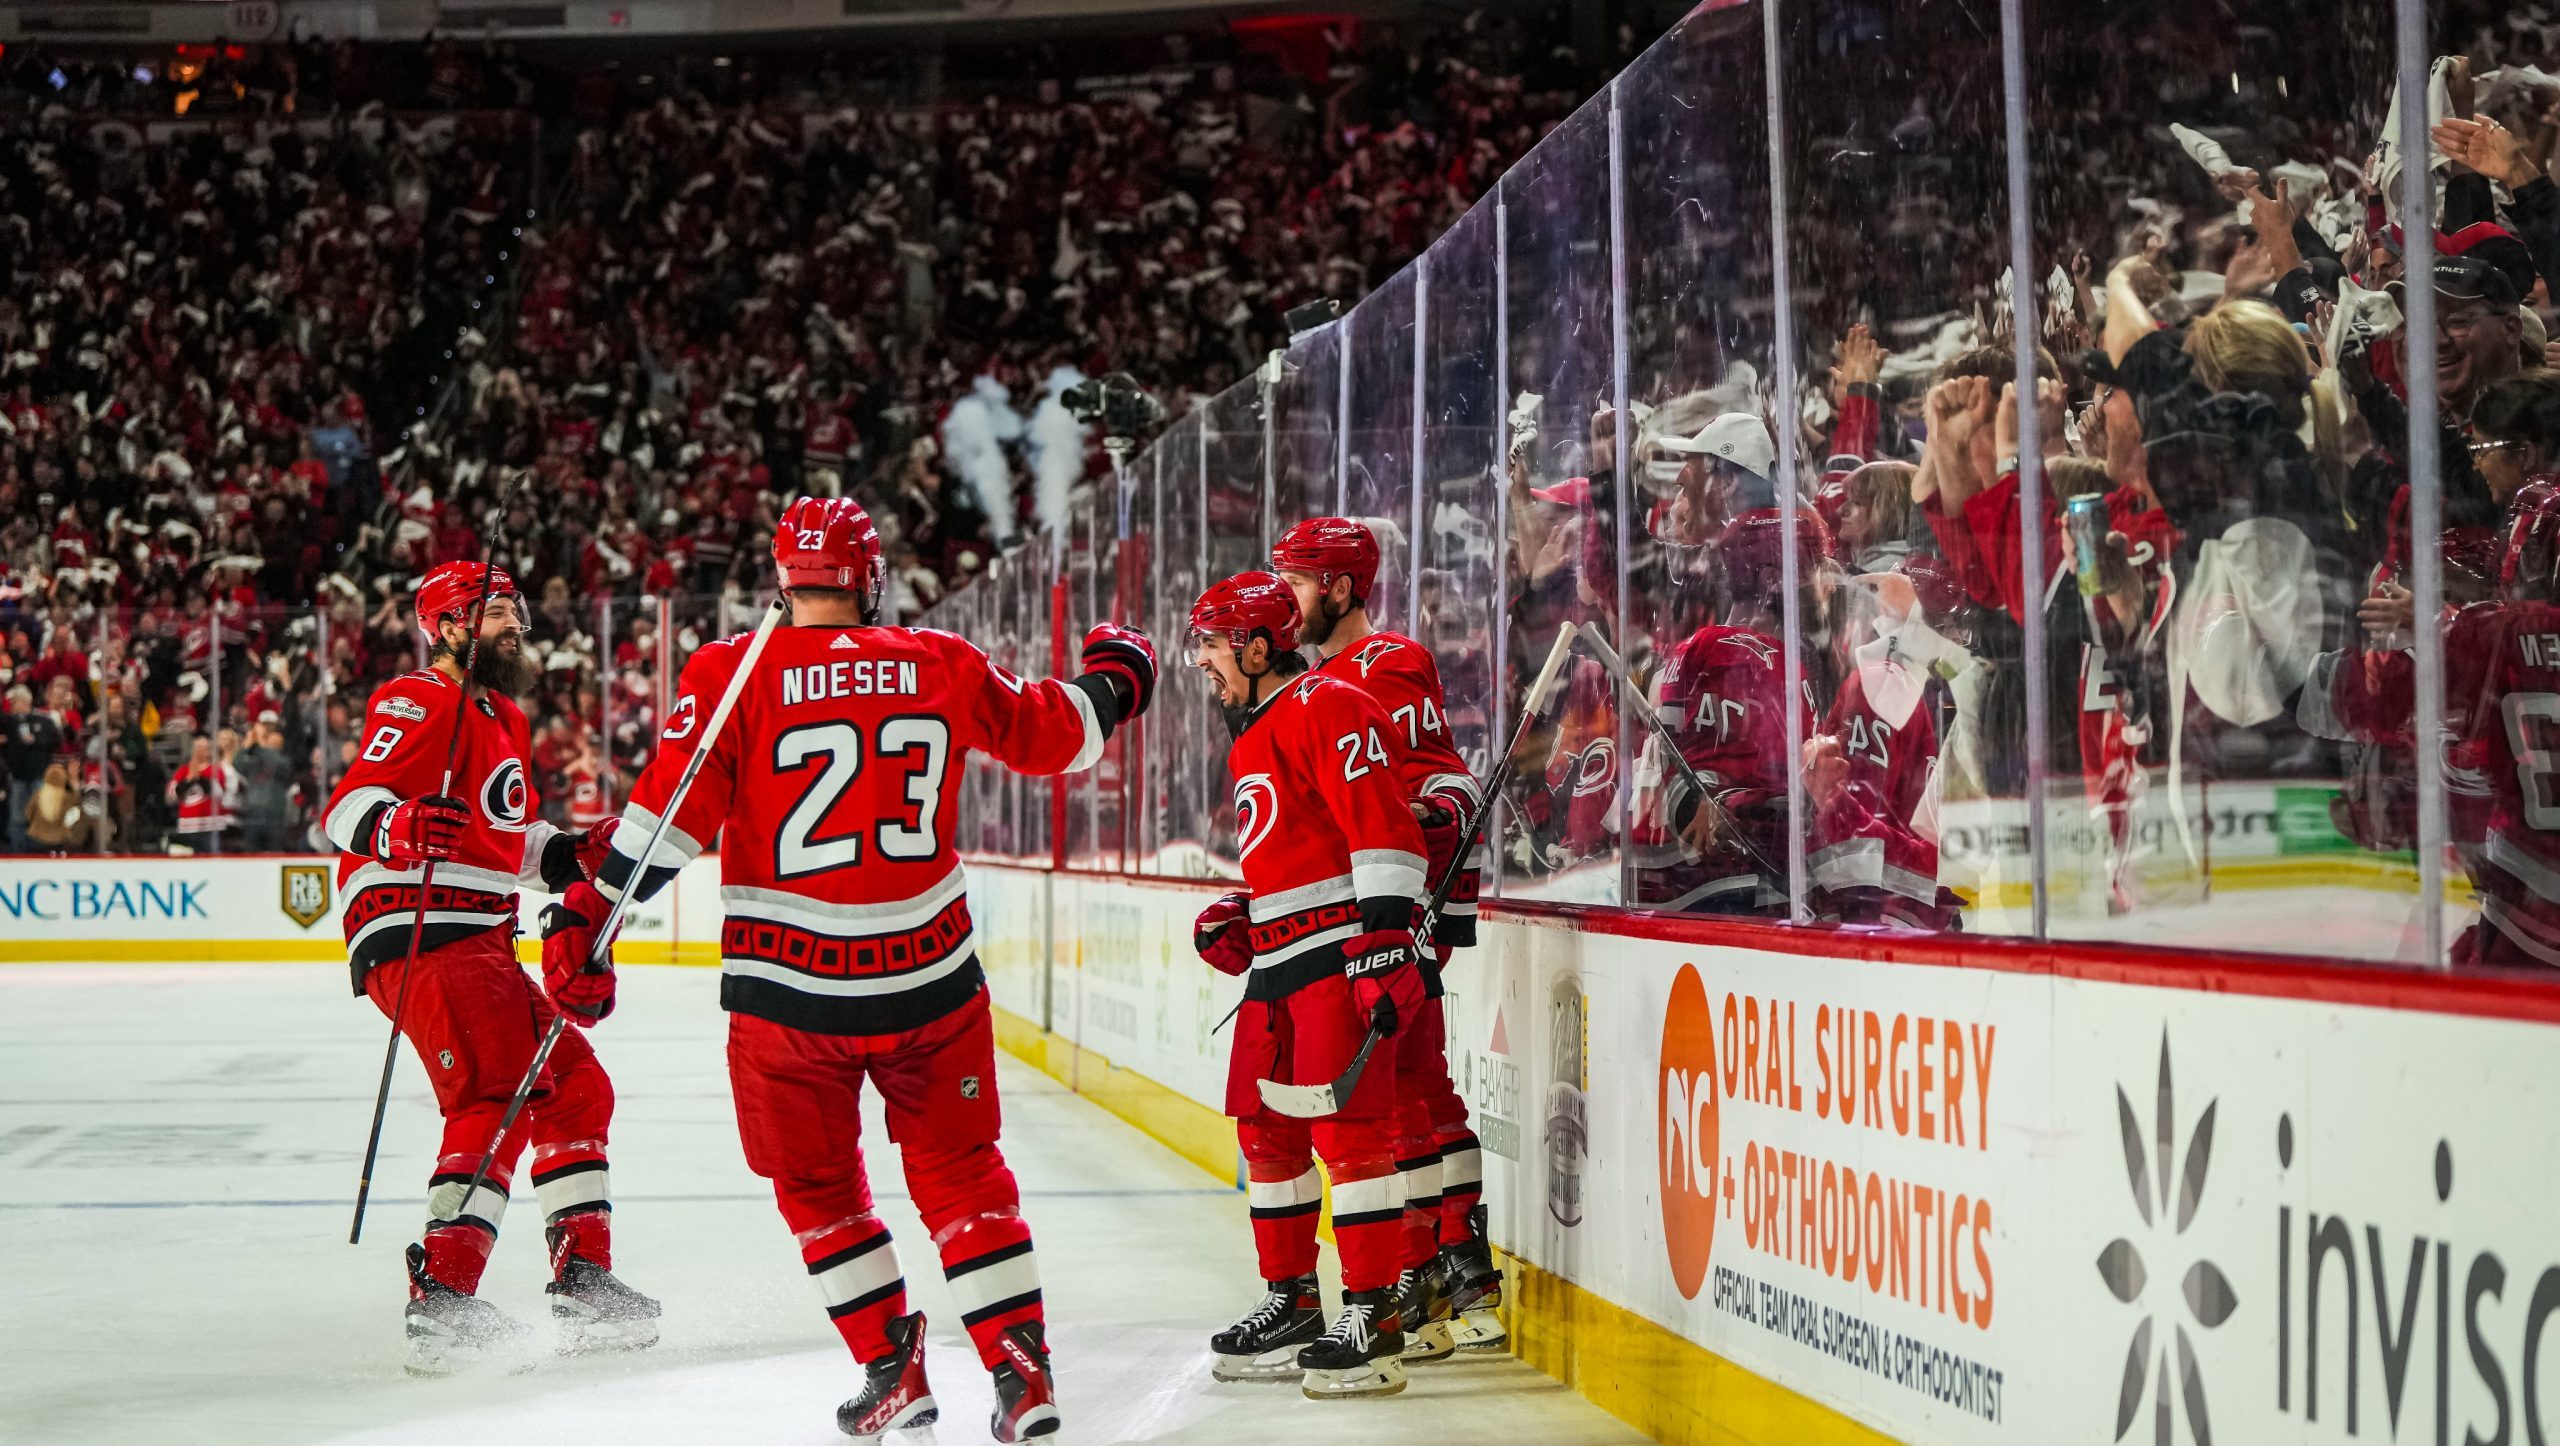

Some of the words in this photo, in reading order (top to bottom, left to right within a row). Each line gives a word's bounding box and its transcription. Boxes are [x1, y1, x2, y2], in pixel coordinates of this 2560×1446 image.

[796, 529, 825, 550] 23
[1235, 582, 1279, 597] TOPGOLF
[782, 659, 918, 706] NOESEN
[362, 725, 404, 763] 8
[1391, 696, 1442, 749] 74
[1336, 726, 1389, 784] 24
[772, 712, 951, 882] 23
[67, 879, 208, 920] BANK
[1479, 1055, 1520, 1120] BAKER
[1723, 991, 1803, 1113] ORAL
[1816, 1003, 1996, 1152] SURGERY
[489, 1128, 506, 1155] CCM
[1666, 1066, 1711, 1198] NC
[552, 1233, 571, 1270] CCM
[1744, 1140, 1994, 1331] ORTHODONTICS
[1001, 1338, 1039, 1374] CCM
[1714, 1264, 1757, 1324] OFFICIAL
[1760, 1281, 1789, 1337] TEAM
[1791, 1294, 1820, 1350] ORAL
[1823, 1305, 1880, 1375] SURGEON
[1883, 1329, 1892, 1380] &
[1895, 1333, 2004, 1426] ORTHODONTIST
[857, 1388, 910, 1435] CCM
